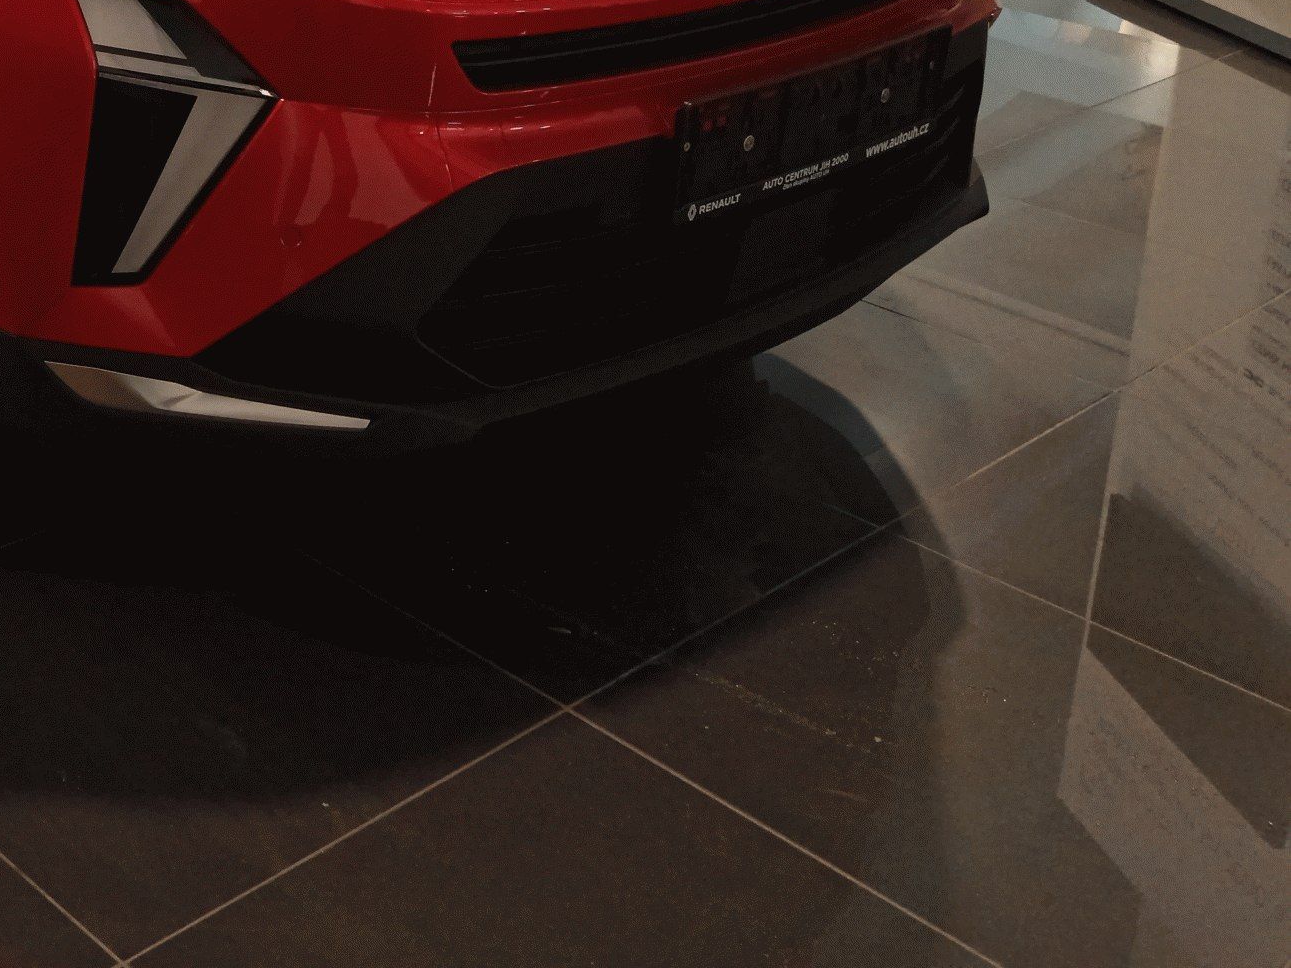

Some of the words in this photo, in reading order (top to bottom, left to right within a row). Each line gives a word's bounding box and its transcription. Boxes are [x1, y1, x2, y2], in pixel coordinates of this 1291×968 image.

[866, 122, 930, 158] www.autouh.cz
[762, 176, 784, 191] AUTO
[785, 164, 819, 183] CENTRUM
[831, 152, 850, 166] 2000
[699, 193, 741, 214] RENAULT
